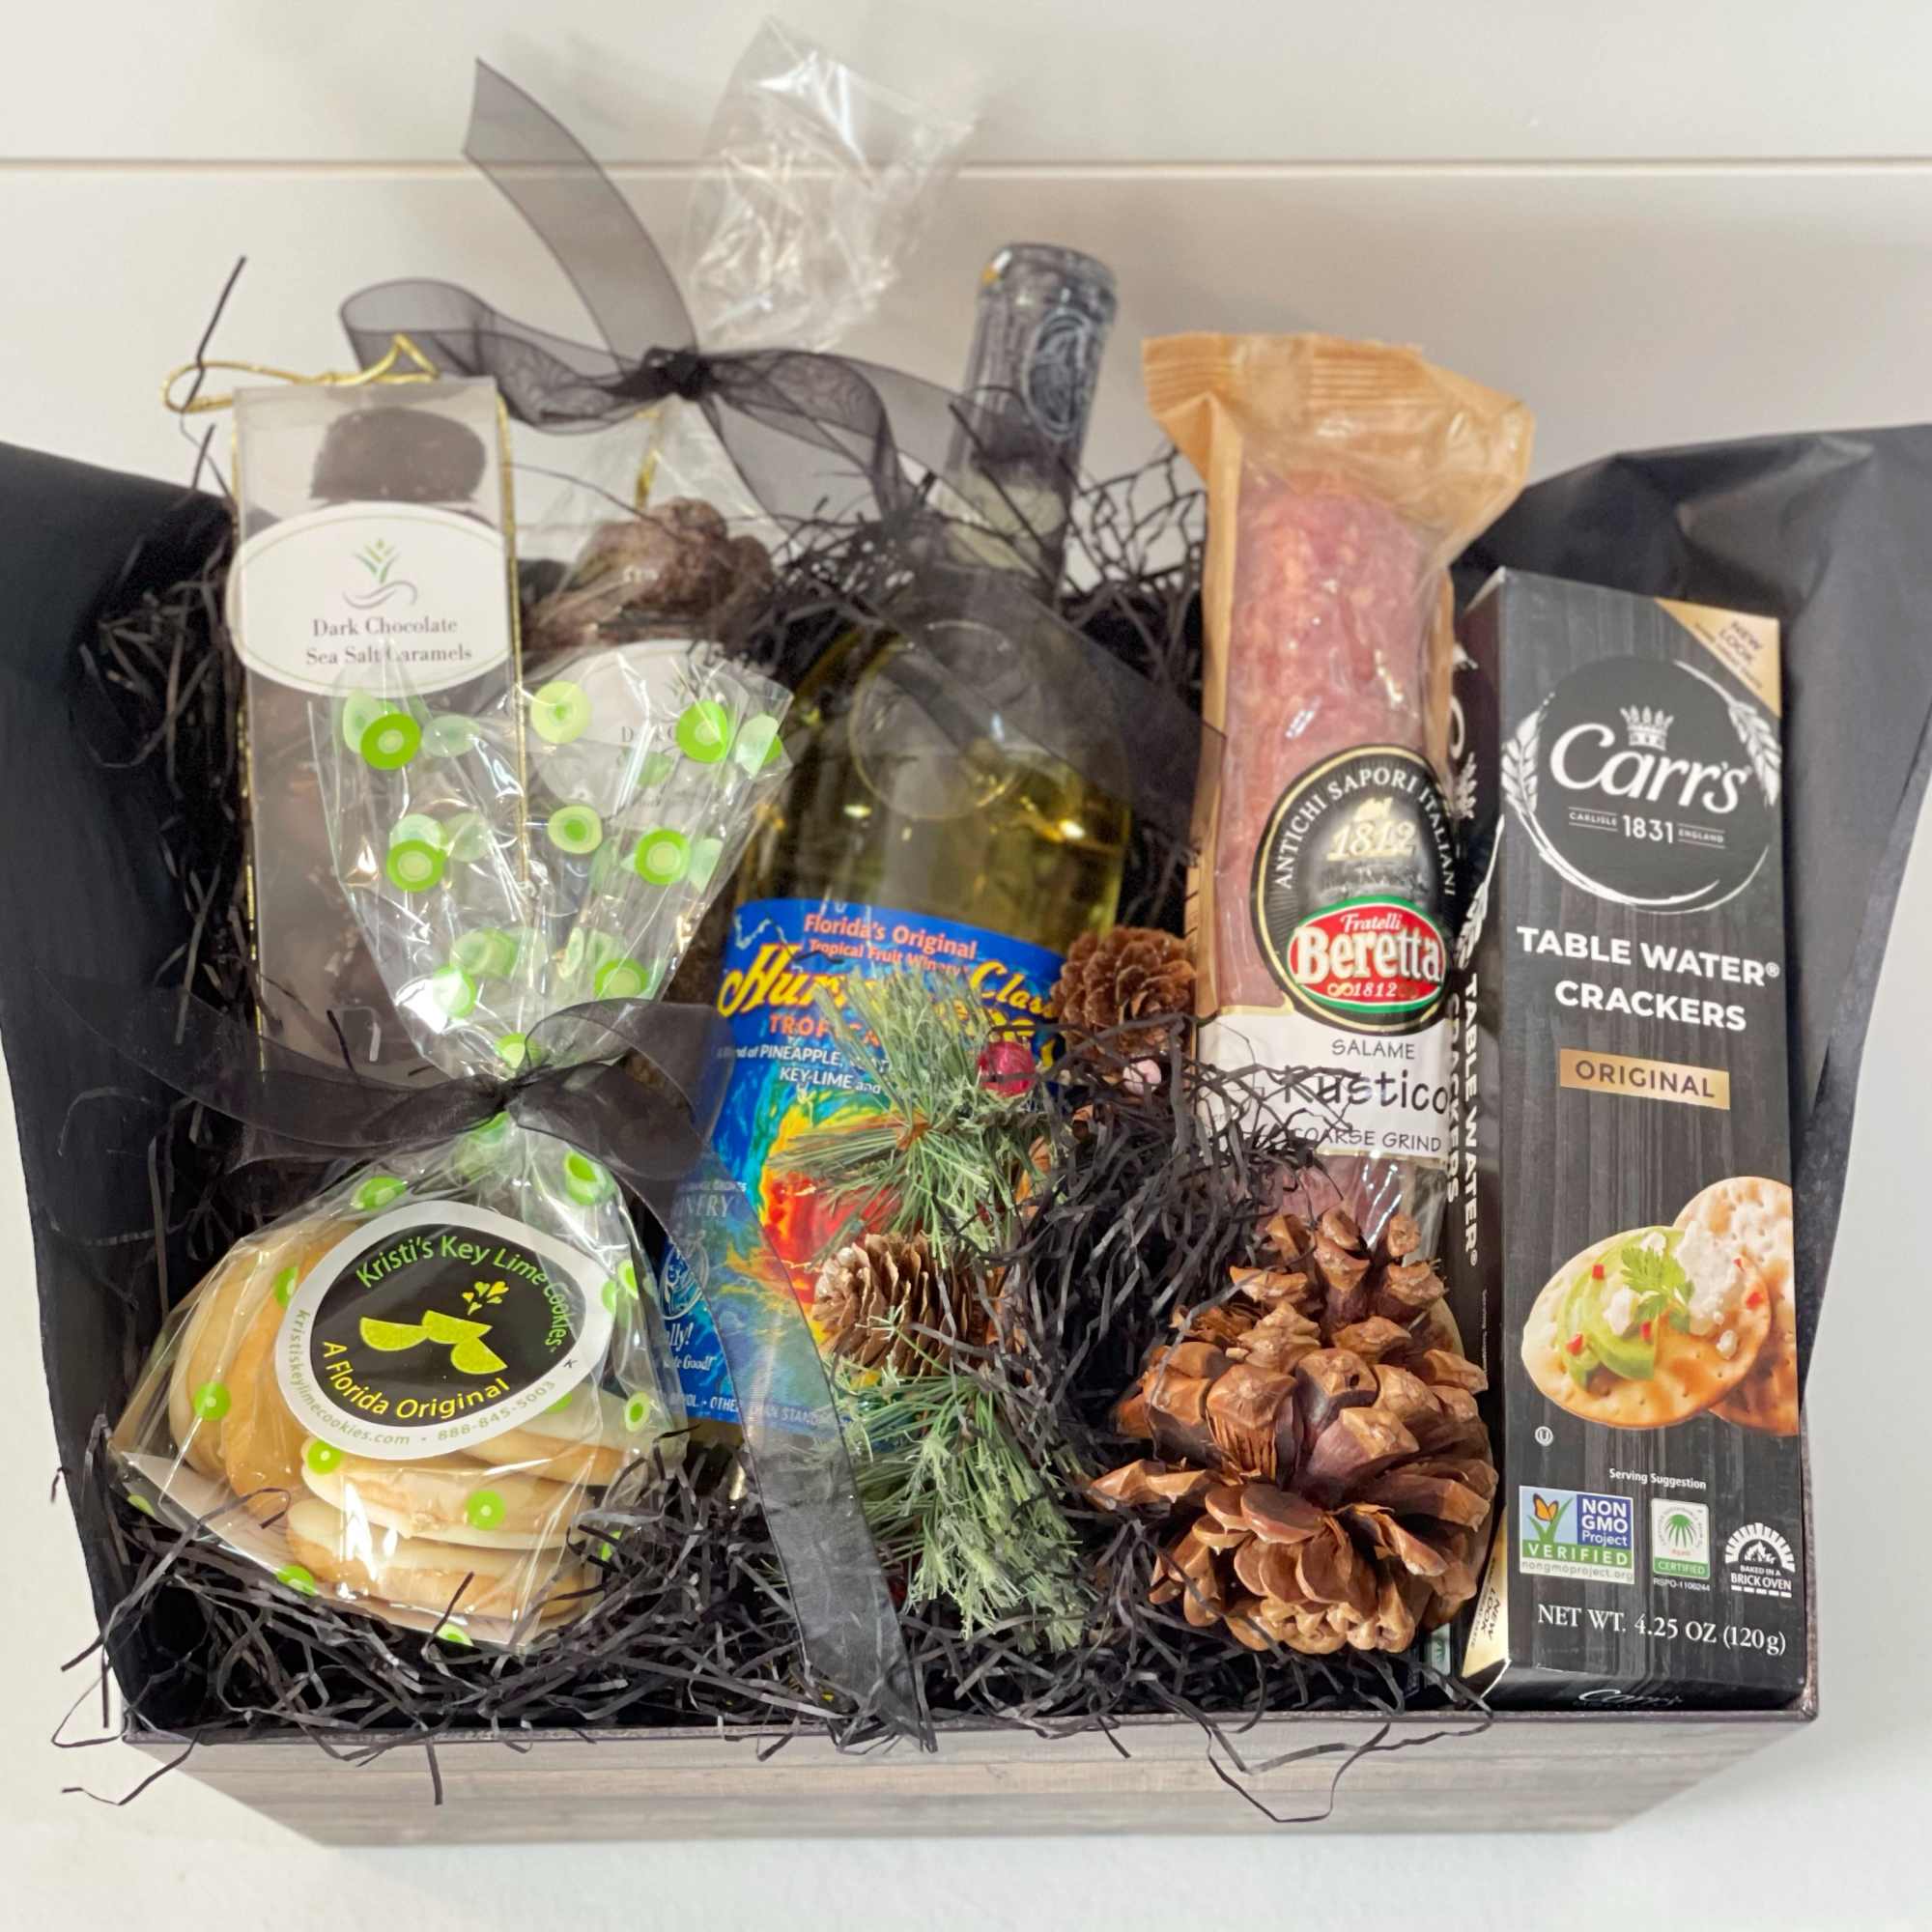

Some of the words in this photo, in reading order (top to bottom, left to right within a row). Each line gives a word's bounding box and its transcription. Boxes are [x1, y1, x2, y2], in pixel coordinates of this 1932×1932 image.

[312, 618, 359, 637] Dark
[365, 615, 458, 635] Chocolate
[305, 647, 338, 666] Sea
[344, 645, 380, 664] Salt
[1548, 723, 1747, 814] Carr's
[1275, 793, 1328, 890] ANTICHI
[1327, 767, 1418, 801] SAPORI
[1418, 787, 1456, 895] ITALIANI
[1569, 811, 1618, 827] CARLISLE
[1622, 814, 1674, 843] 1831
[1678, 828, 1724, 843] ENGLAND
[1340, 913, 1403, 933] Fratelli
[804, 914, 886, 941] Florida's
[892, 924, 978, 959] Original
[1517, 926, 1632, 965] TABLE
[809, 938, 864, 958] Tropical
[1293, 925, 1441, 984] Beretta
[1352, 982, 1398, 998] 1812
[1554, 980, 1747, 1032] CRACKERS
[1464, 972, 1478, 1102] TABLE
[1331, 1038, 1416, 1060] SALAME
[1576, 1060, 1716, 1098] ORIGINAL
[1382, 1132, 1442, 1152] GRIND
[355, 1236, 434, 1289] Kristi's
[440, 1236, 490, 1265] Key
[493, 1247, 548, 1286] Lime
[543, 1282, 572, 1347] Cookies
[323, 1340, 349, 1359] A
[325, 1359, 389, 1414] Florida
[396, 1377, 510, 1419] Original
[438, 1379, 556, 1440] 888-845-5003
[1608, 1467, 1648, 1485] Serving
[1650, 1472, 1707, 1491] Suggestion
[1582, 1498, 1627, 1518] NON
[1581, 1515, 1628, 1534] GMO
[1581, 1530, 1628, 1548] Project
[1527, 1543, 1628, 1565] VERIFIED
[1521, 1560, 1633, 1582] nongmoproject.org
[1658, 1560, 1705, 1576] CERTIFIED
[1740, 1565, 1765, 1576] BAKED
[1730, 1573, 1761, 1588] BRICK
[1761, 1577, 1792, 1591] OVEN
[1538, 1604, 1581, 1628] NET
[1587, 1608, 1627, 1633] WT.
[1634, 1612, 1679, 1639] 4.25
[1685, 1621, 1717, 1643] OZ
[1722, 1625, 1787, 1656] (120g)
